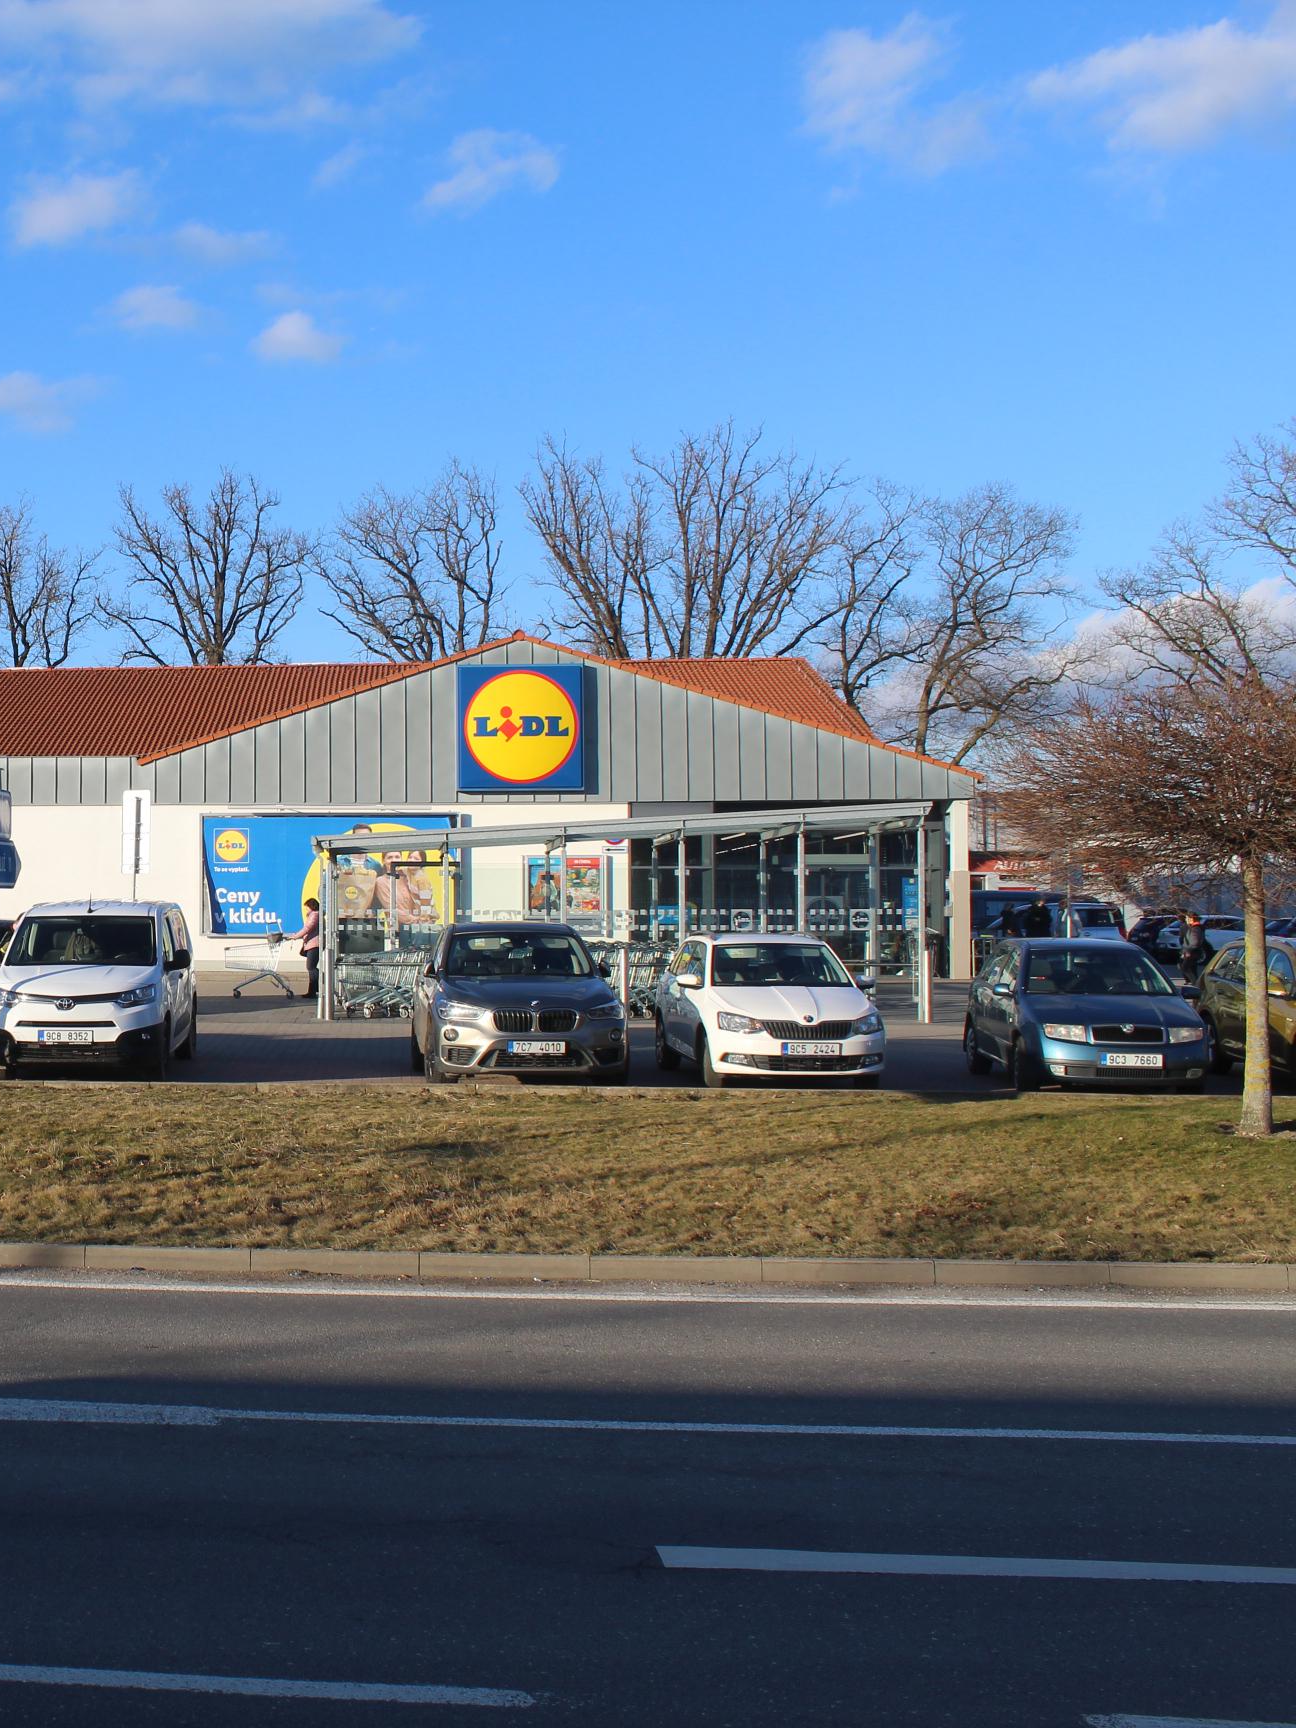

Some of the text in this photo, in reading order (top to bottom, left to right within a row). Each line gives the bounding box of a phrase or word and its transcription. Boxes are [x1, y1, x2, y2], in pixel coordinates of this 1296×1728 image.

[216, 888, 260, 906] Ceny
[214, 912, 225, 923] v
[46, 1032, 88, 1041] 9C8 8352
[516, 1043, 561, 1052] 7C7 4010
[790, 1044, 835, 1054] 9C5 2424
[1109, 1055, 1158, 1065] 9C3 7660
